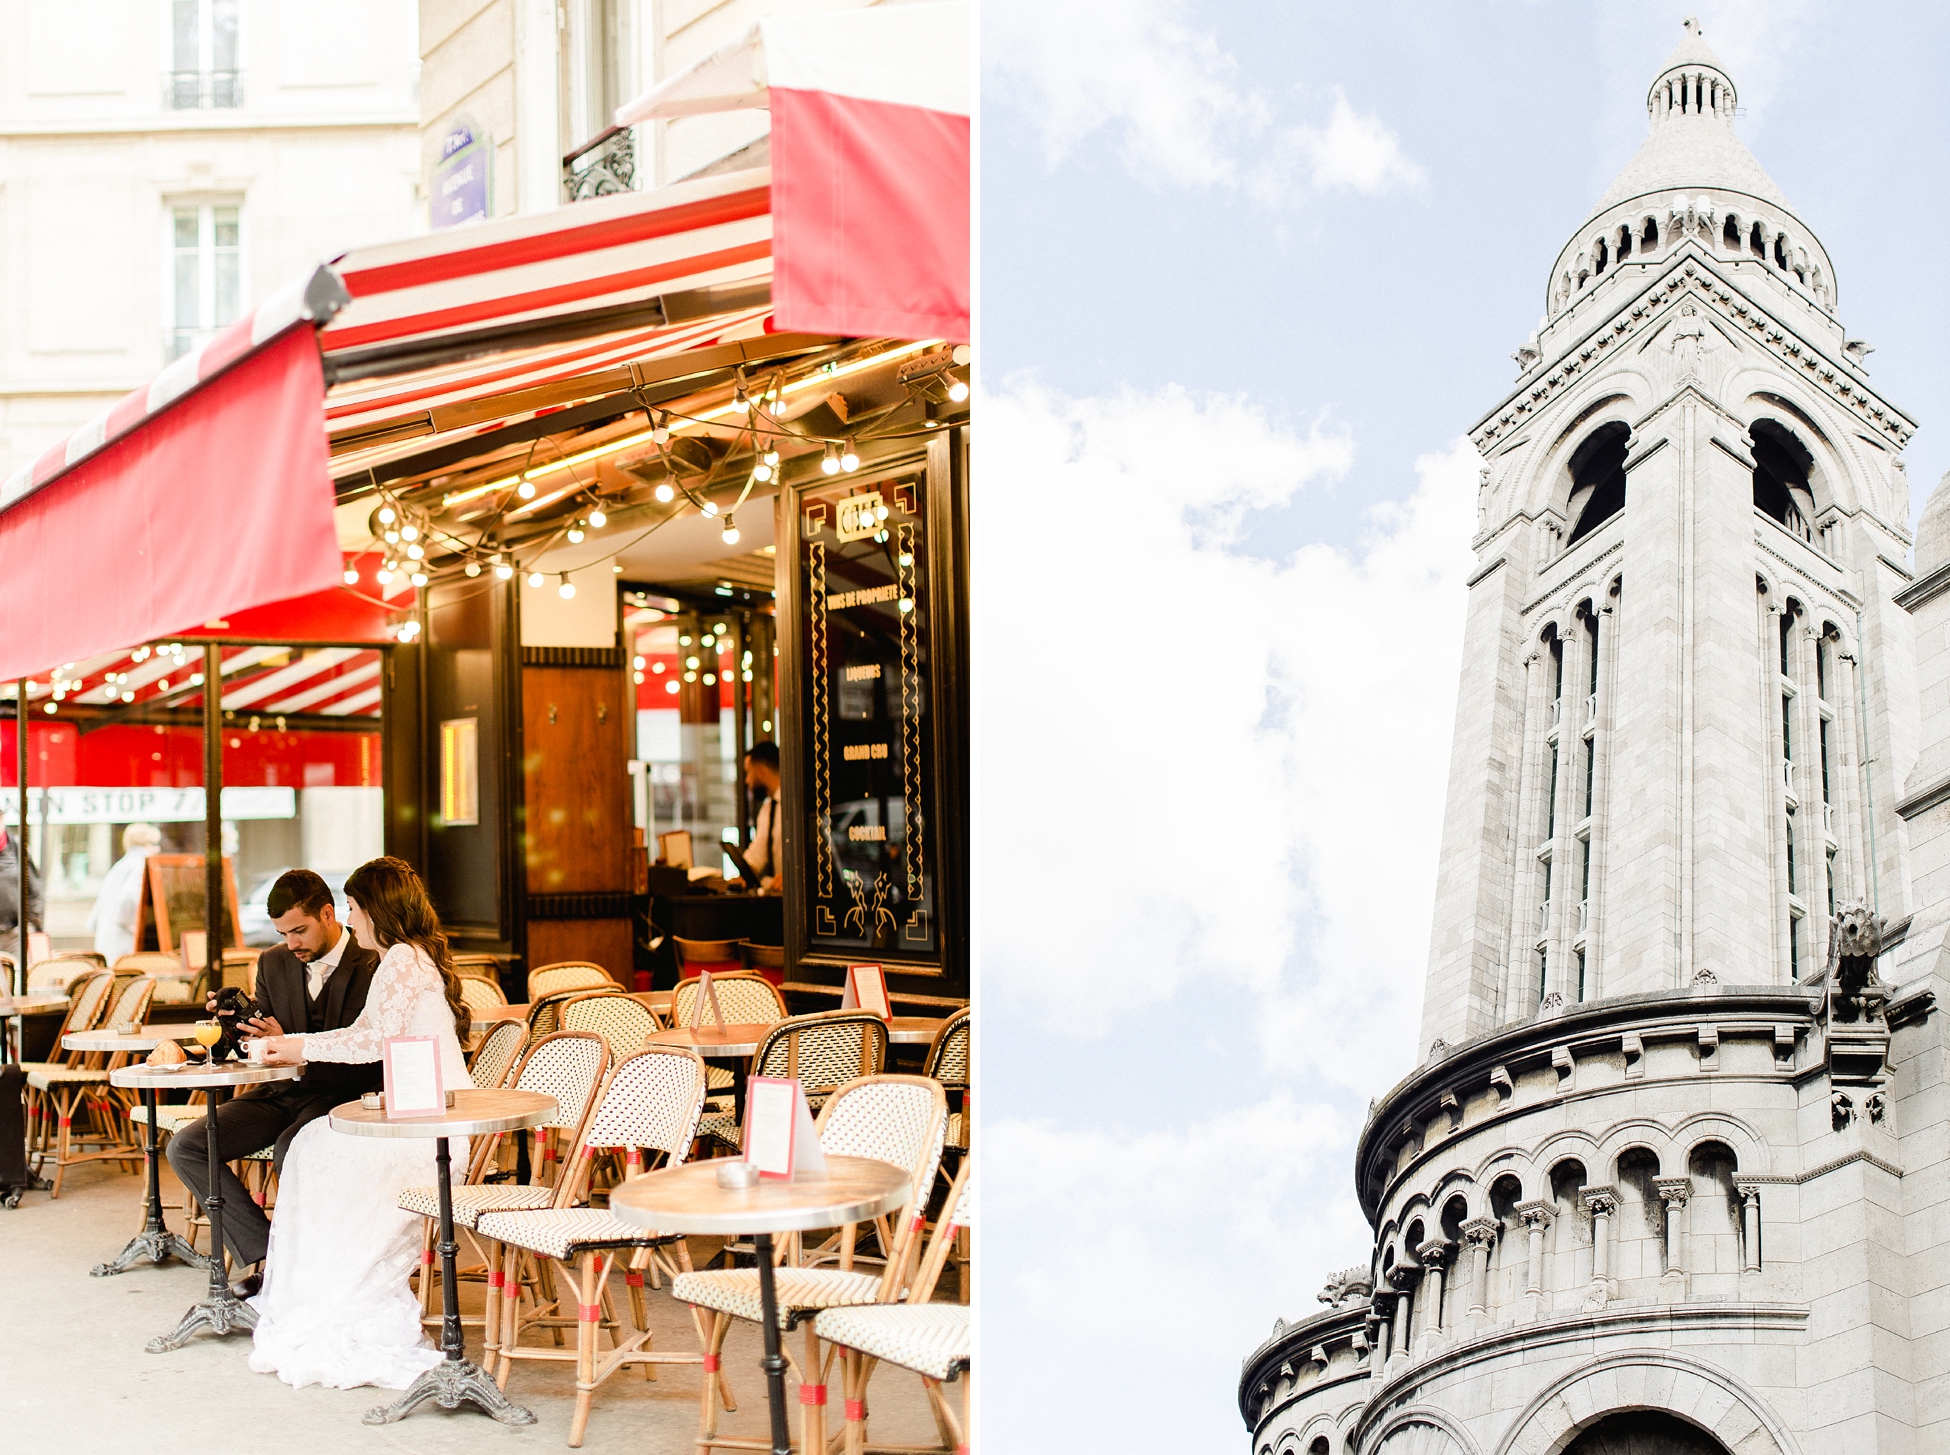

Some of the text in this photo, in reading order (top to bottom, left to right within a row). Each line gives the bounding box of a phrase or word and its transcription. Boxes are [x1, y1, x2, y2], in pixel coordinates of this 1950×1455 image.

[845, 591, 856, 608] DE
[846, 663, 881, 682] LIQUEURS
[844, 743, 888, 760] GRAND CRU
[83, 792, 154, 813] STOP
[849, 825, 886, 841] COCKTAIL
